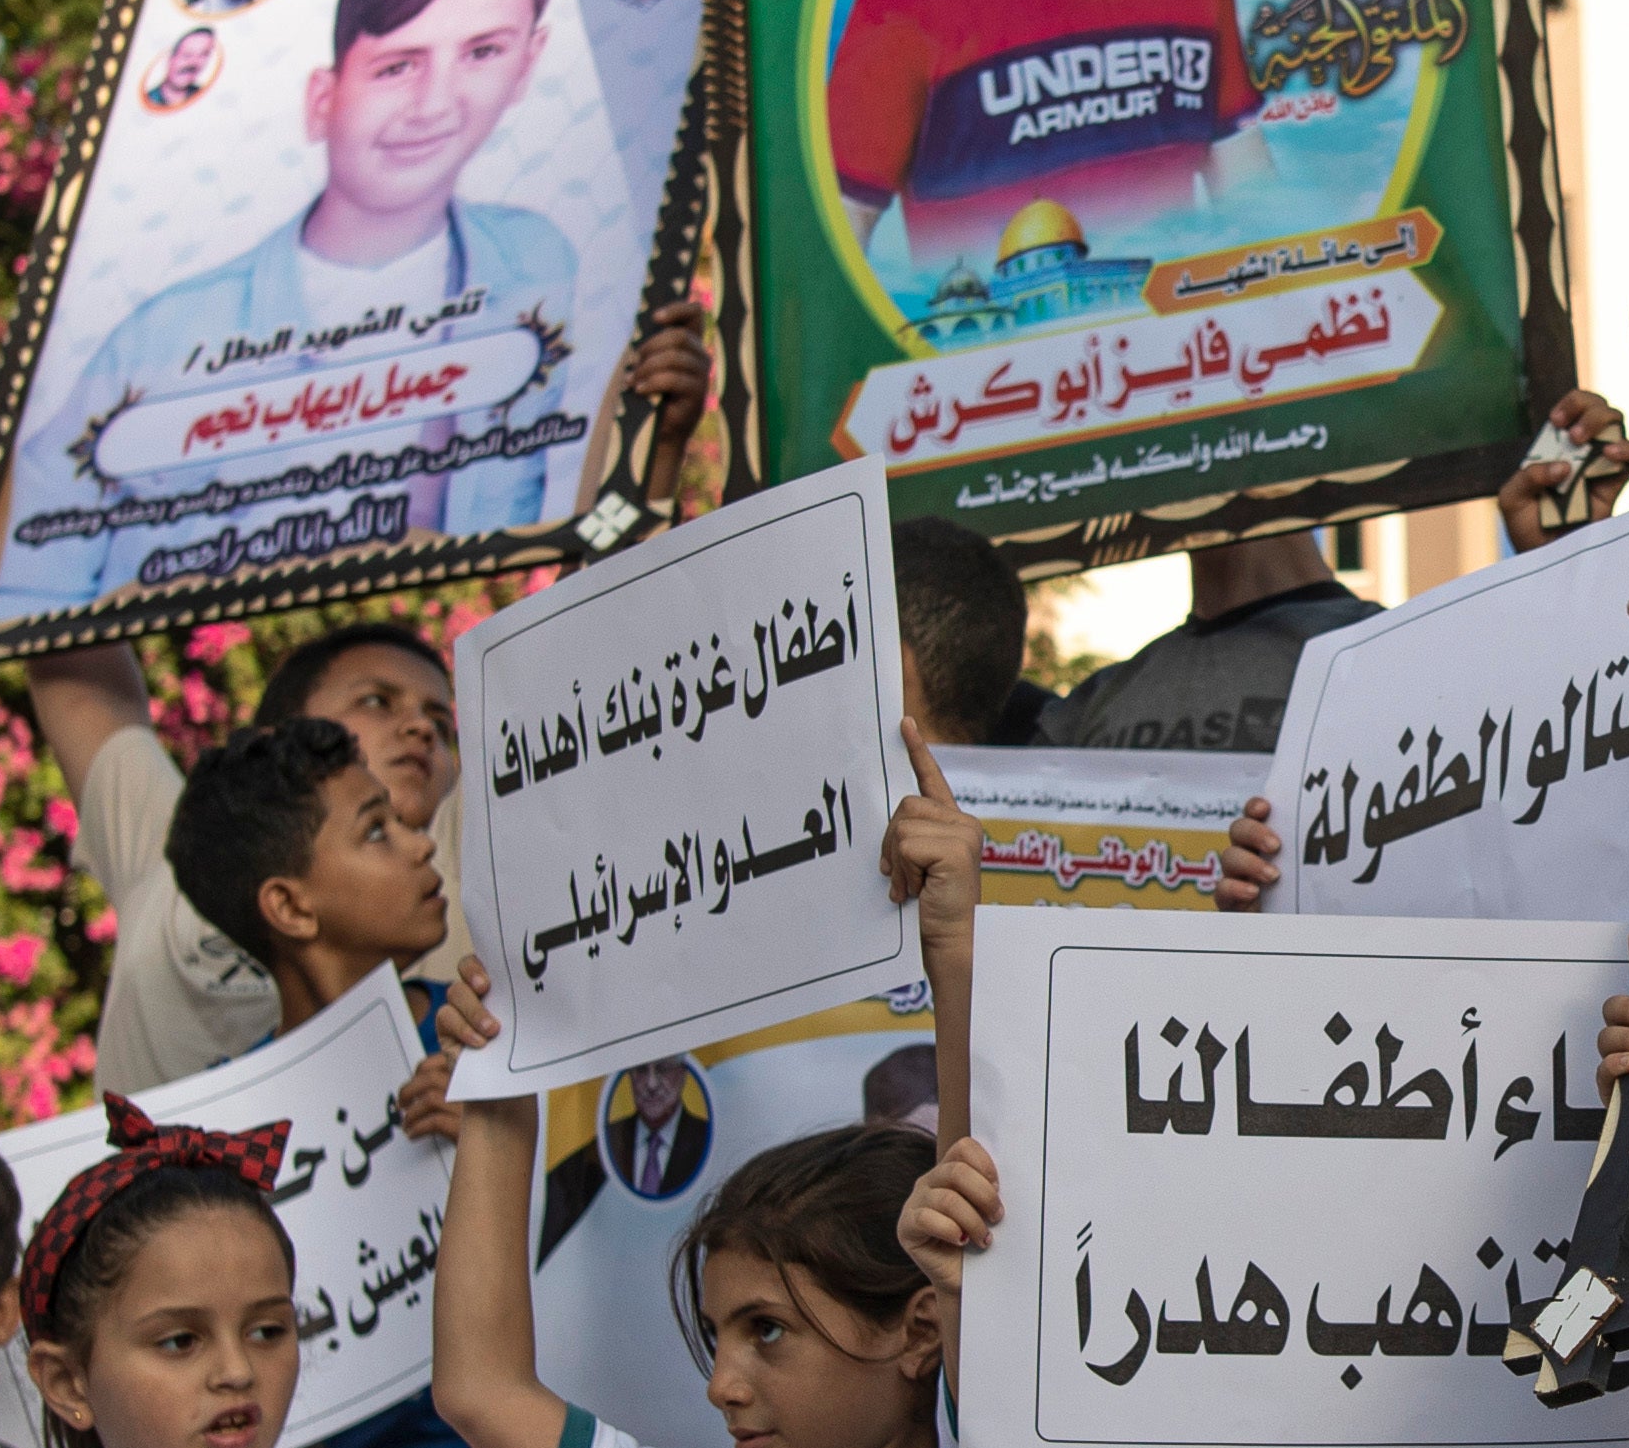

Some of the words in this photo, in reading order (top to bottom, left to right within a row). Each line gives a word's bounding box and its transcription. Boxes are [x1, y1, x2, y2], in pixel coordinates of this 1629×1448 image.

[978, 38, 1171, 116] UNDER
[1008, 87, 1164, 145] ARMOUR
[1175, 252, 1277, 299] الشهيد
[1279, 242, 1361, 274] عائلة
[1369, 222, 1417, 267] إلى
[205, 328, 292, 374] البطل
[300, 303, 405, 353] الشهيد
[1111, 318, 1230, 410] فايز
[1239, 288, 1391, 391] نظمي
[360, 362, 469, 419] جميل
[888, 361, 1043, 453] كرش
[1050, 335, 1104, 425] أبو
[183, 396, 257, 456] نجم
[1108, 433, 1213, 479] وأسكنه
[1213, 427, 1252, 461] الله
[1253, 423, 1328, 451] رحمه
[956, 472, 1040, 510] جناته
[1039, 456, 1108, 502] فسيح
[670, 632, 738, 741] غزة
[742, 570, 859, 719] أطفال
[492, 679, 589, 797] أهداف
[597, 666, 663, 760] بنك
[1303, 704, 1510, 884] الطفولة
[710, 777, 853, 915] العدو
[1058, 837, 1168, 889] الوطني
[522, 815, 705, 993] الإسرائيلي
[1123, 1007, 1480, 1142] أطفالنا
[1494, 1026, 1613, 1161] اء
[340, 1092, 403, 1187] من
[348, 1203, 443, 1337] لعيش
[1076, 1221, 1291, 1386] هدراً
